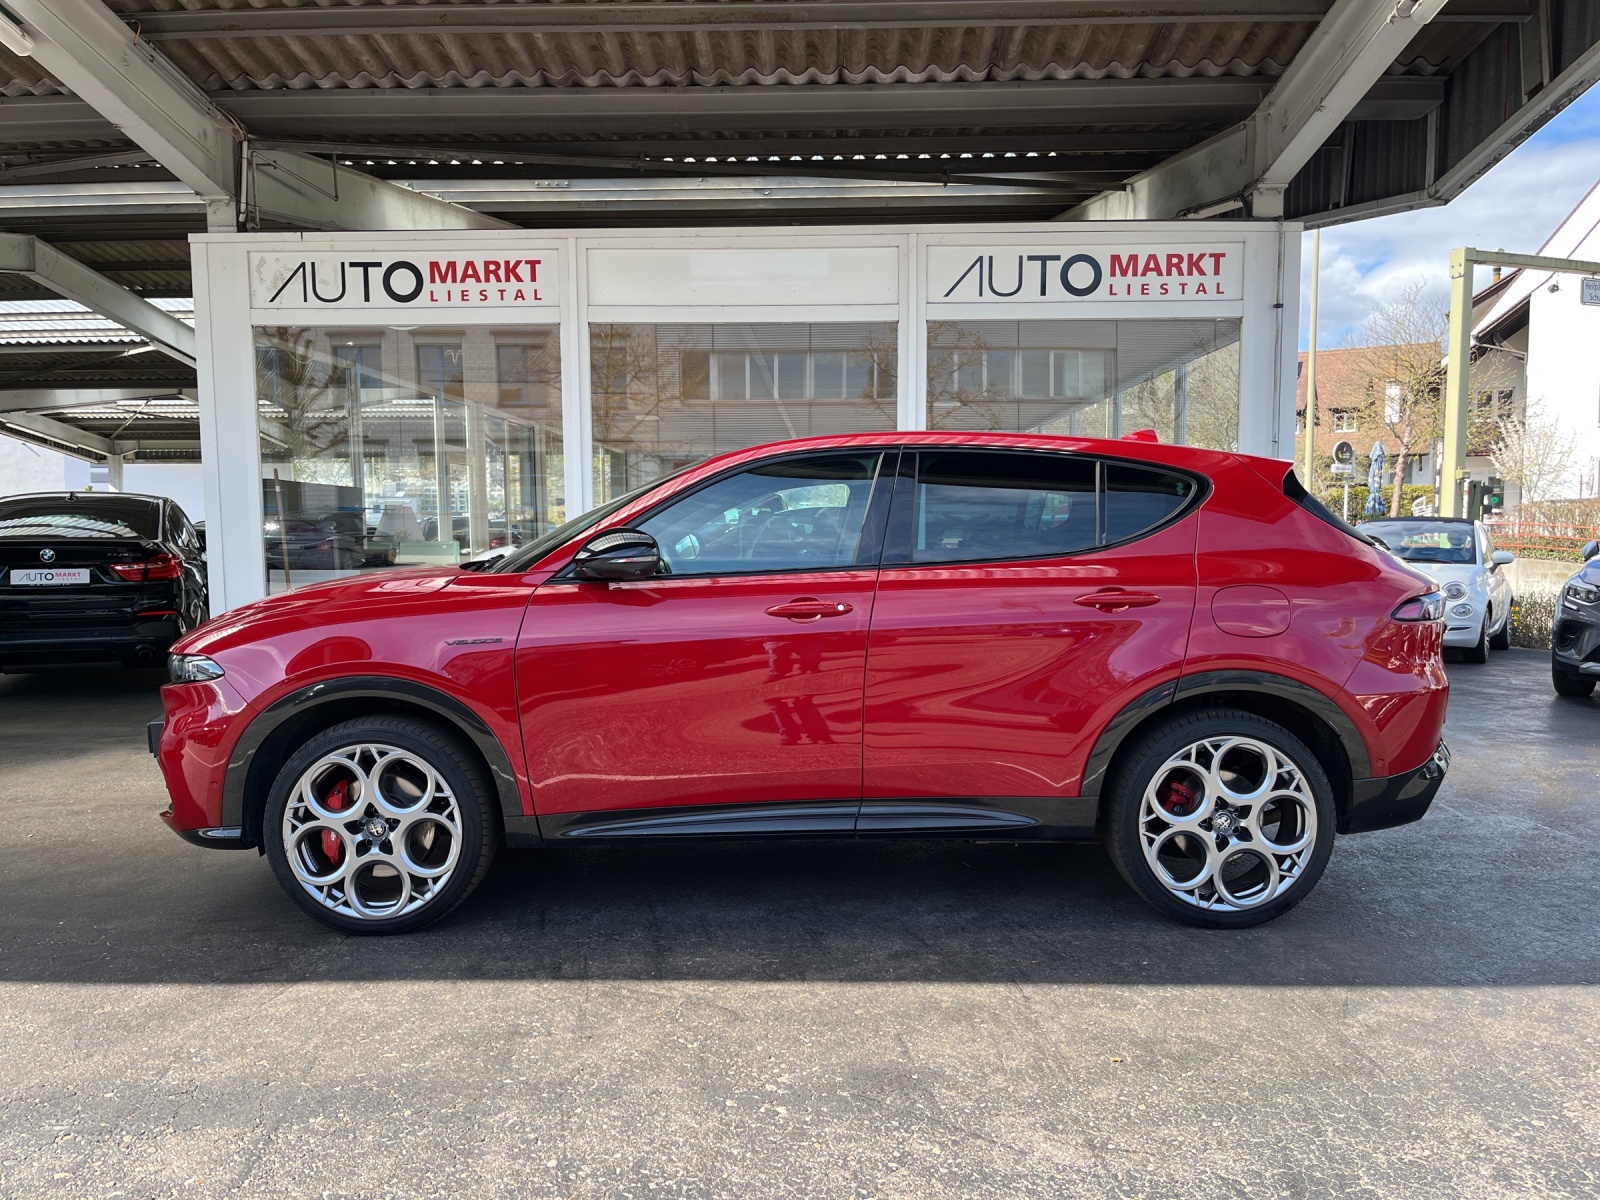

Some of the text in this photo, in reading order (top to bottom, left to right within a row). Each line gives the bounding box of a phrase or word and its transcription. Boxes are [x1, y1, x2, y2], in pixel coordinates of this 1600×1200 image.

[268, 259, 542, 303] AUTO MARKT
[943, 252, 1226, 297] AUTO MARKT
[429, 288, 543, 302] LIESTAL
[1109, 282, 1225, 296] LIESTAL
[20, 572, 54, 582] AUTO
